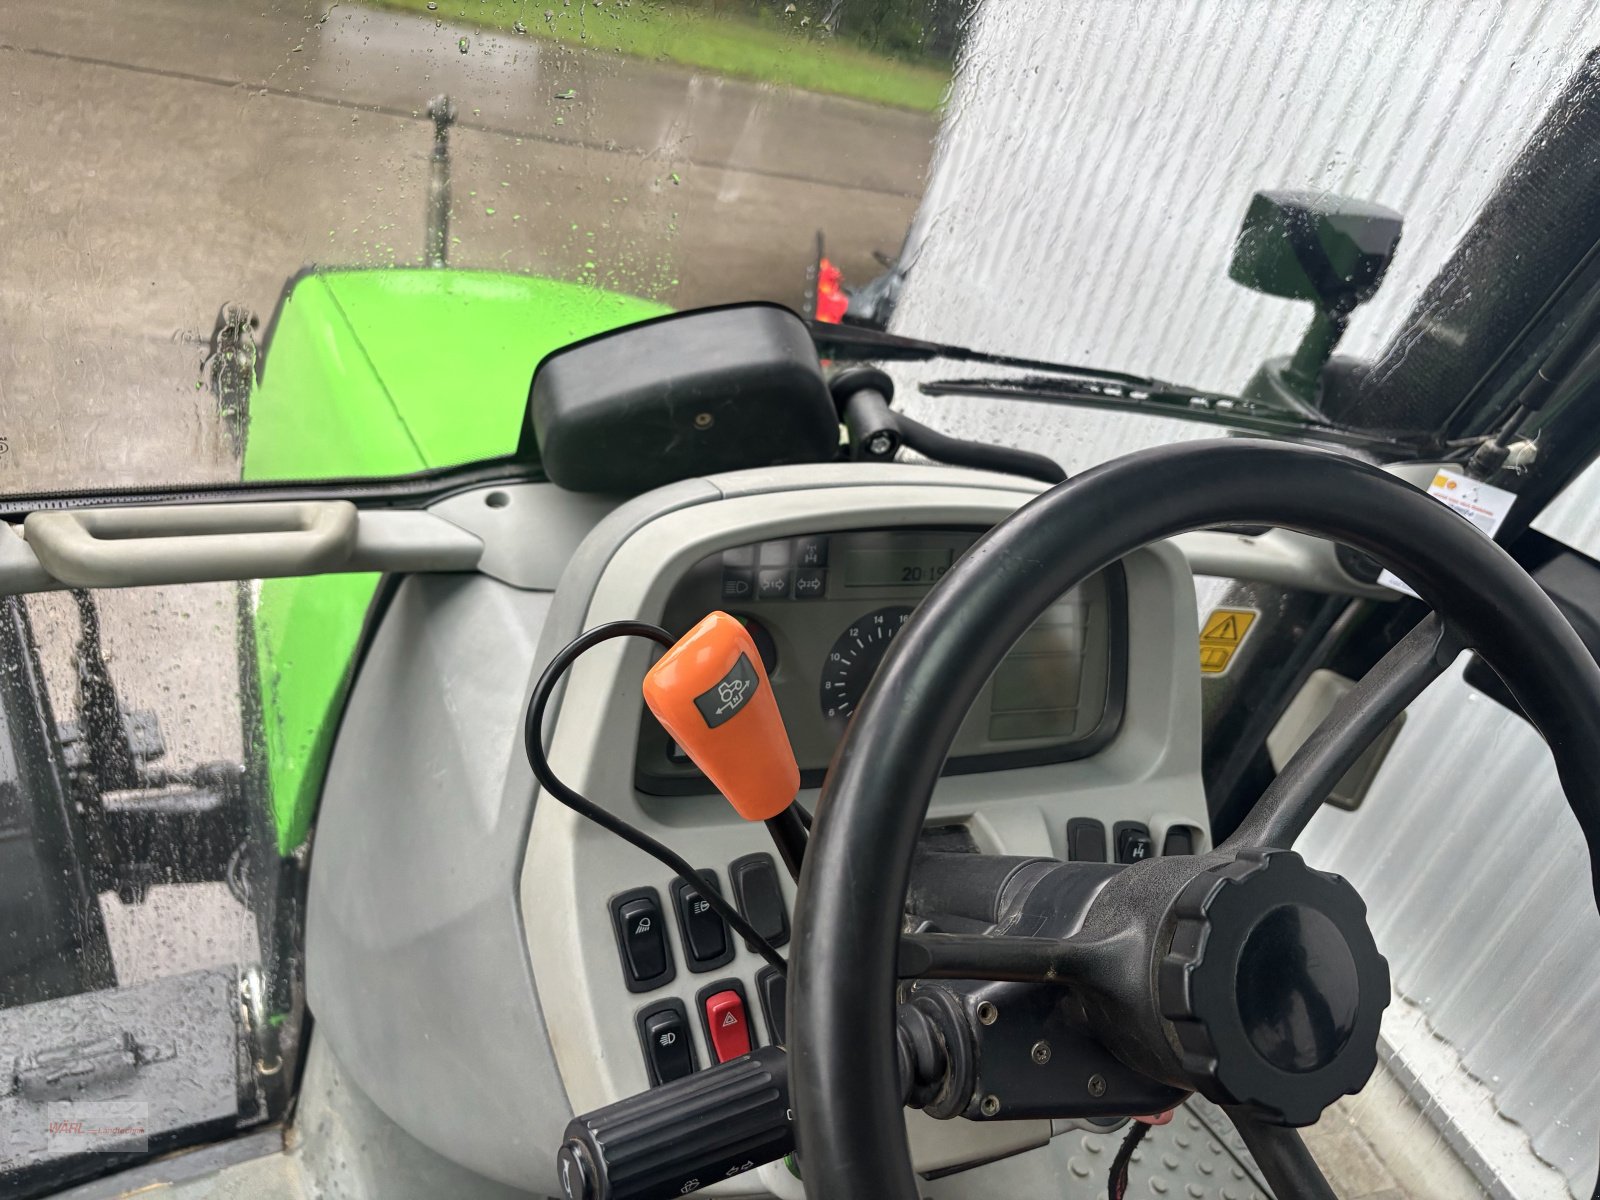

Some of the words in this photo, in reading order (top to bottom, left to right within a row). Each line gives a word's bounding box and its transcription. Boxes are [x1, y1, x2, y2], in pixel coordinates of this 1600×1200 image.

[874, 615, 884, 624] 14
[850, 628, 859, 637] 12
[830, 653, 841, 661] 10
[825, 681, 832, 689] 8
[732, 695, 739, 703] N
[828, 708, 835, 717] 6
